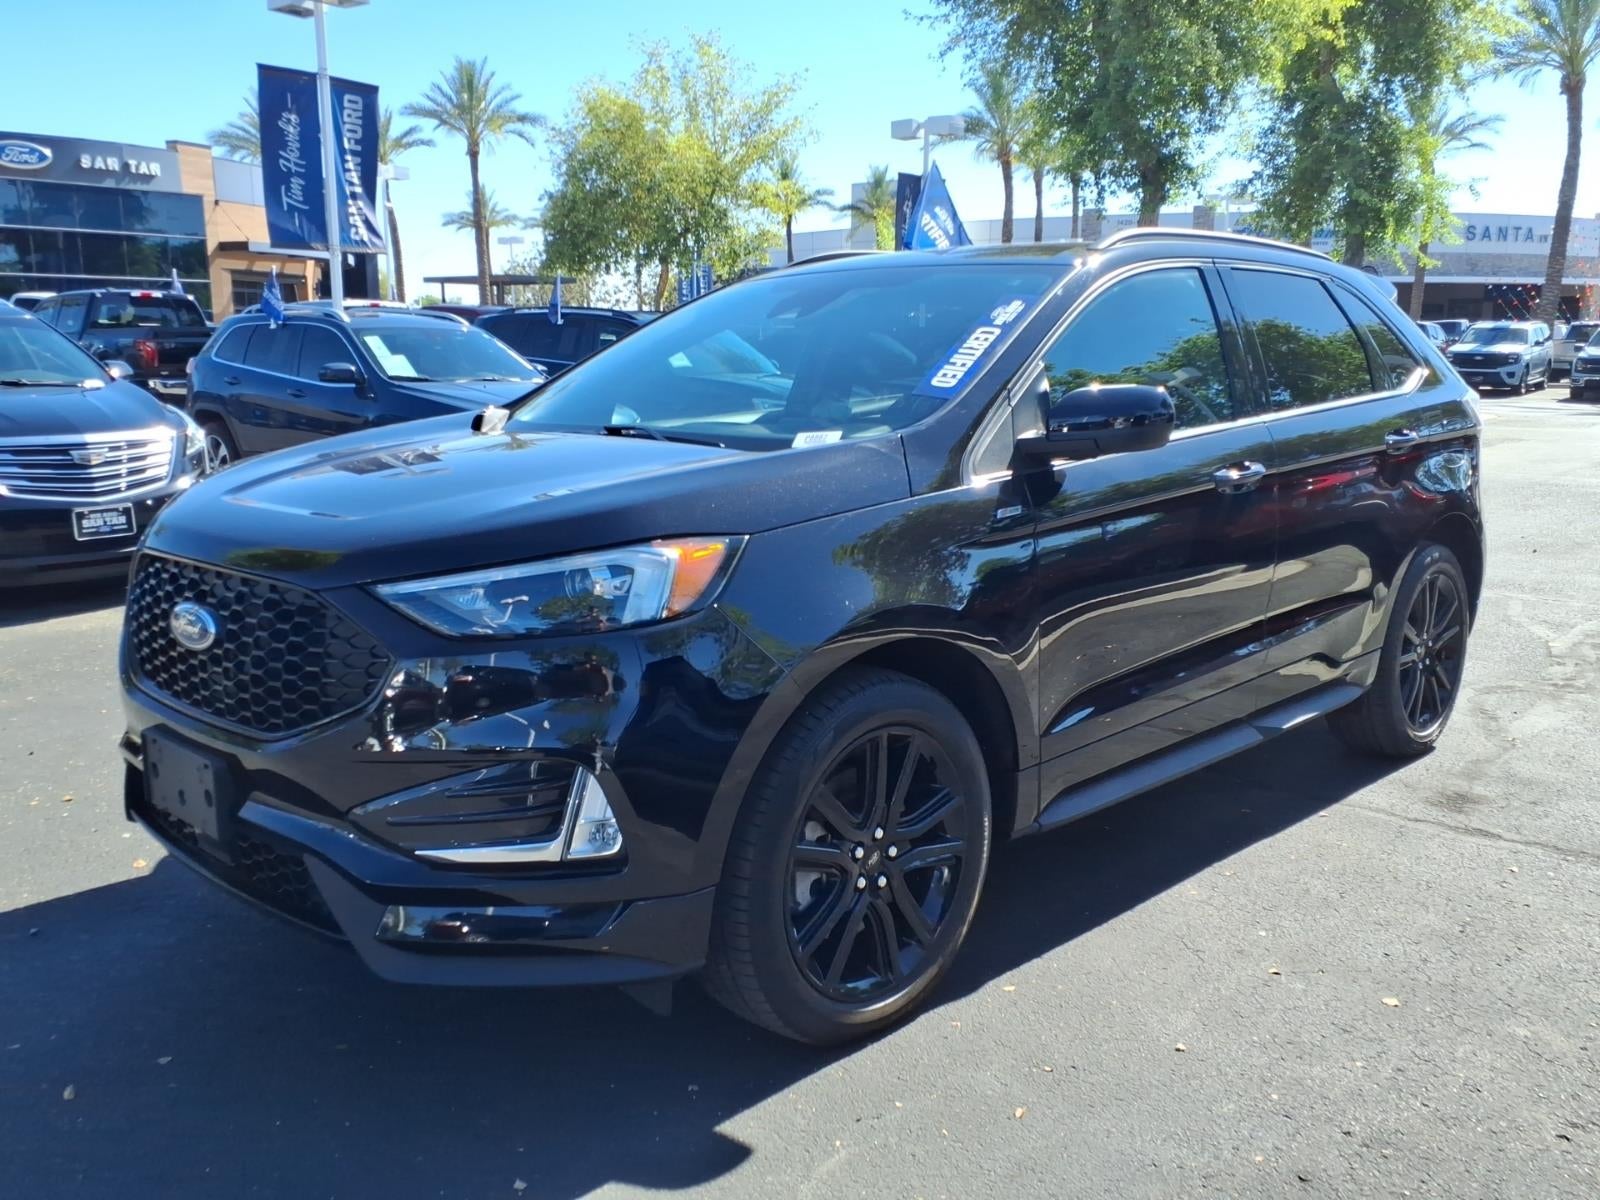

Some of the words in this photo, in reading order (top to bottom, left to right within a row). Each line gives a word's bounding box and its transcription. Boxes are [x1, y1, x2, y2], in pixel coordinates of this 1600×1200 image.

[342, 93, 363, 152] FORD
[1, 146, 40, 163] Ford
[79, 153, 119, 172] SAN
[128, 159, 161, 177] TAN
[281, 175, 310, 212] Tim
[344, 155, 363, 195] TAN
[930, 326, 1002, 388] CERTIFIED
[81, 517, 104, 528] SAN
[104, 515, 127, 526] TAN
